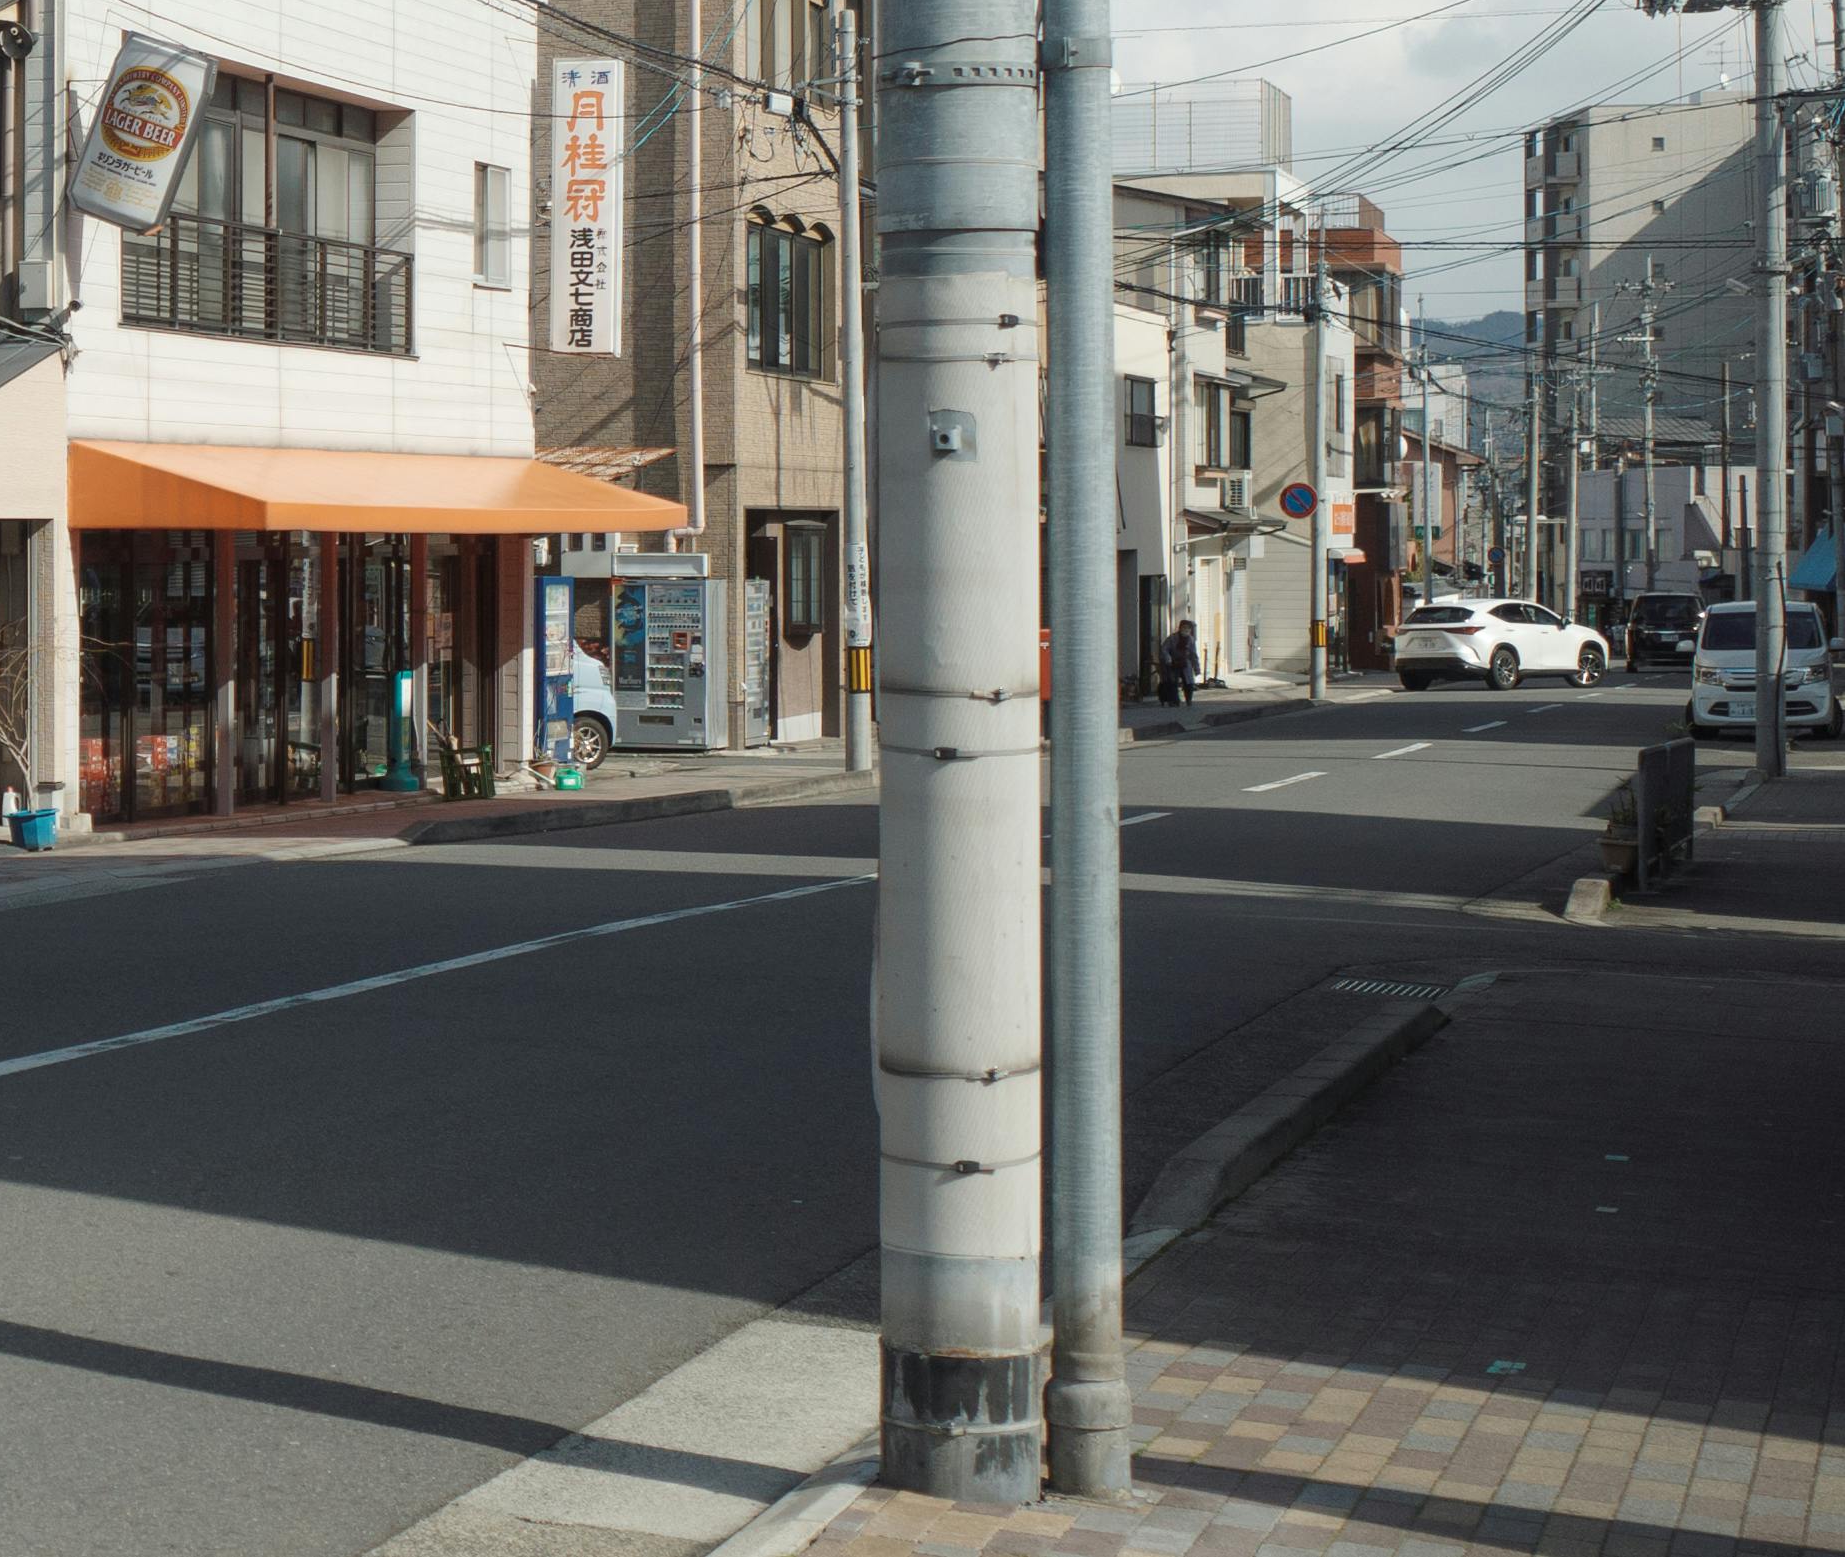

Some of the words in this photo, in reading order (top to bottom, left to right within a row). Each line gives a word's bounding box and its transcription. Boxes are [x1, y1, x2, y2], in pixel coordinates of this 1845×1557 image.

[561, 69, 611, 88] 清酒
[104, 107, 141, 136] LAGER
[143, 122, 176, 147] BEER
[97, 151, 154, 180] キリンラガービール
[561, 90, 608, 222] 月桂冠
[568, 227, 595, 348] 浅田文七商店
